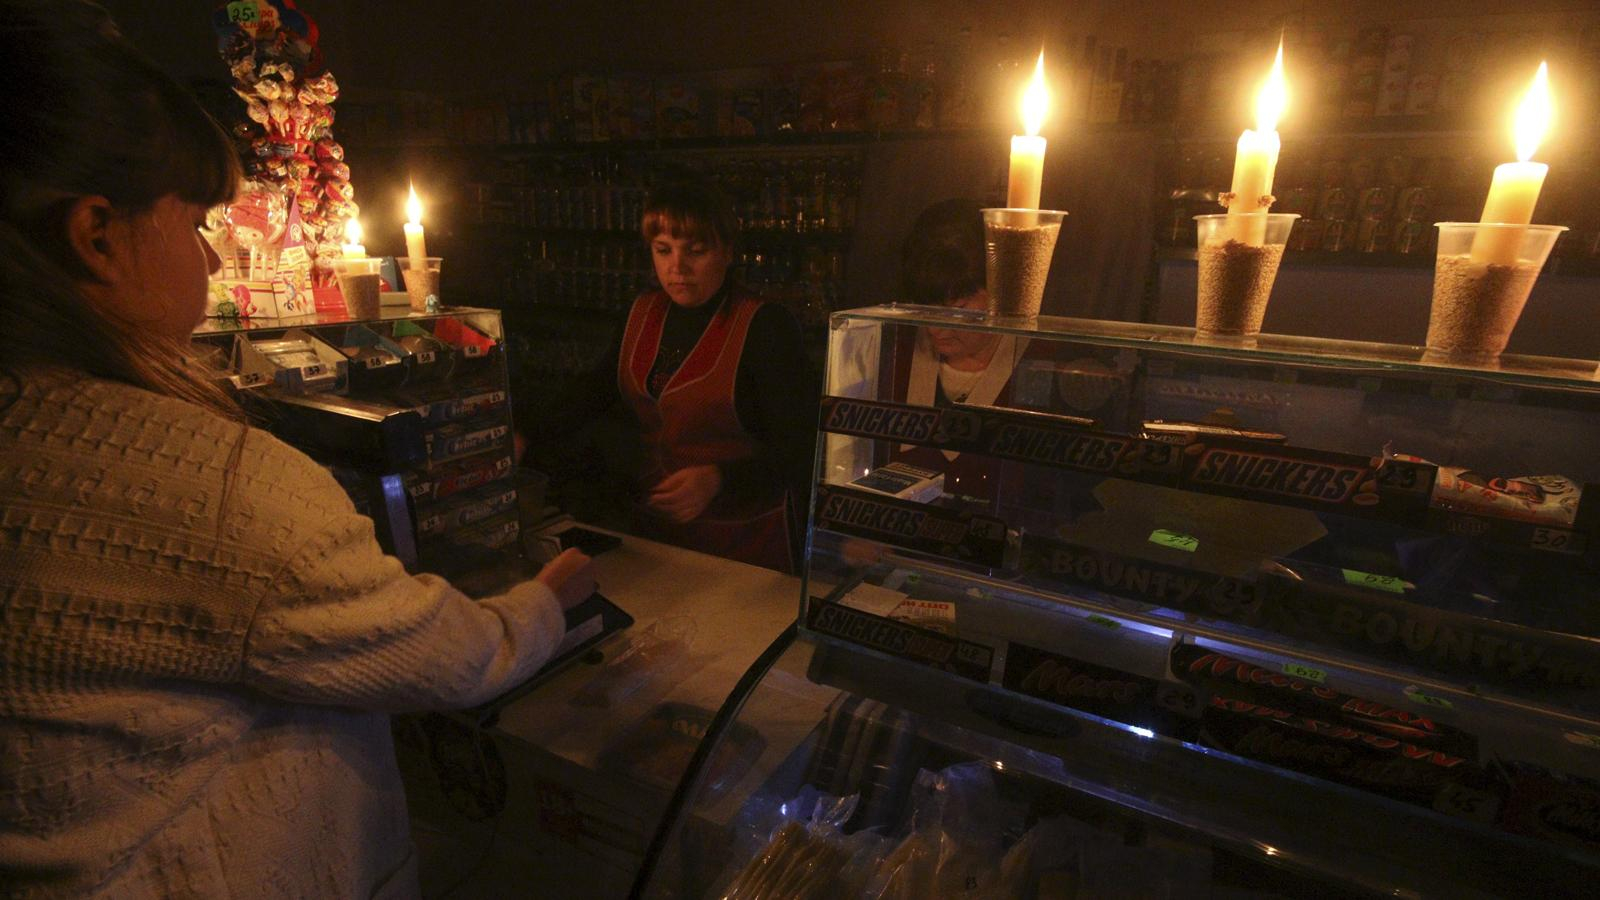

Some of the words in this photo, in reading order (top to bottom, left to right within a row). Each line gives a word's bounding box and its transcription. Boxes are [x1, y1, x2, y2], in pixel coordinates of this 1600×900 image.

[831, 401, 937, 440] SNICKERS
[995, 424, 1124, 470] SNICKERS
[1200, 450, 1357, 500] SNICKERS
[824, 495, 925, 537] SNICKERS
[1051, 549, 1199, 603] BOUNTY
[817, 606, 914, 652] SNICKERS
[1331, 603, 1545, 677] BOUNTY
[1020, 658, 1143, 704] Mars
